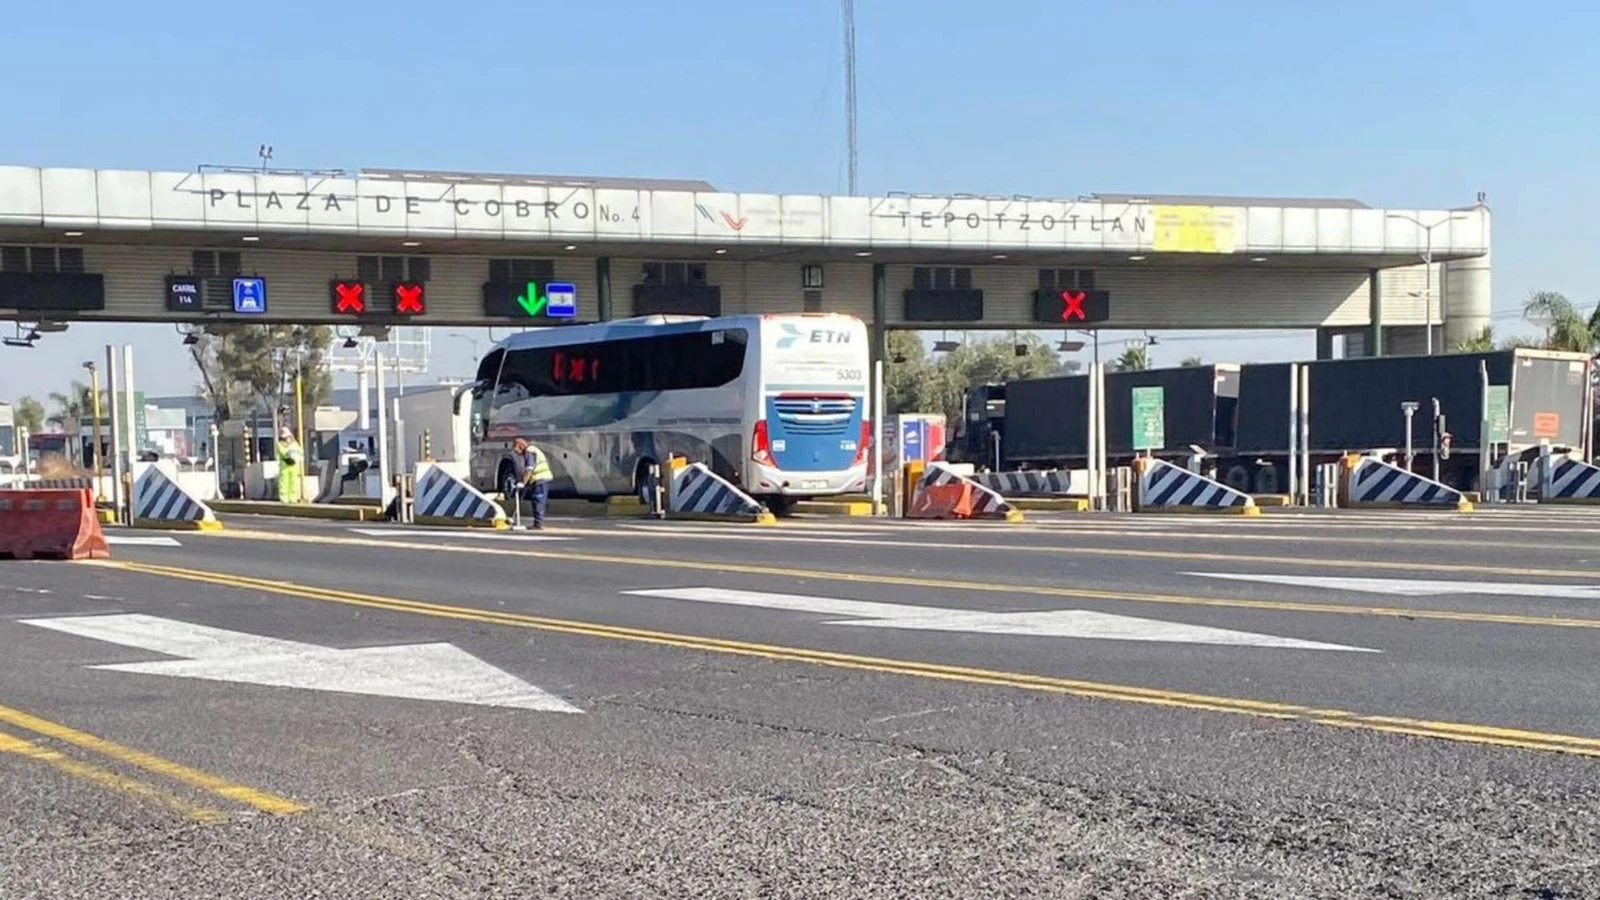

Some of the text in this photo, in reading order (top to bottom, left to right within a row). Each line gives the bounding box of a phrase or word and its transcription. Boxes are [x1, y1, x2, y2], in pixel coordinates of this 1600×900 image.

[210, 189, 641, 223] PLAZA DE COBRO No. 4
[899, 211, 1146, 233] TEPOTZOTLAN
[809, 329, 852, 344] ETN
[836, 368, 863, 381] 5303
